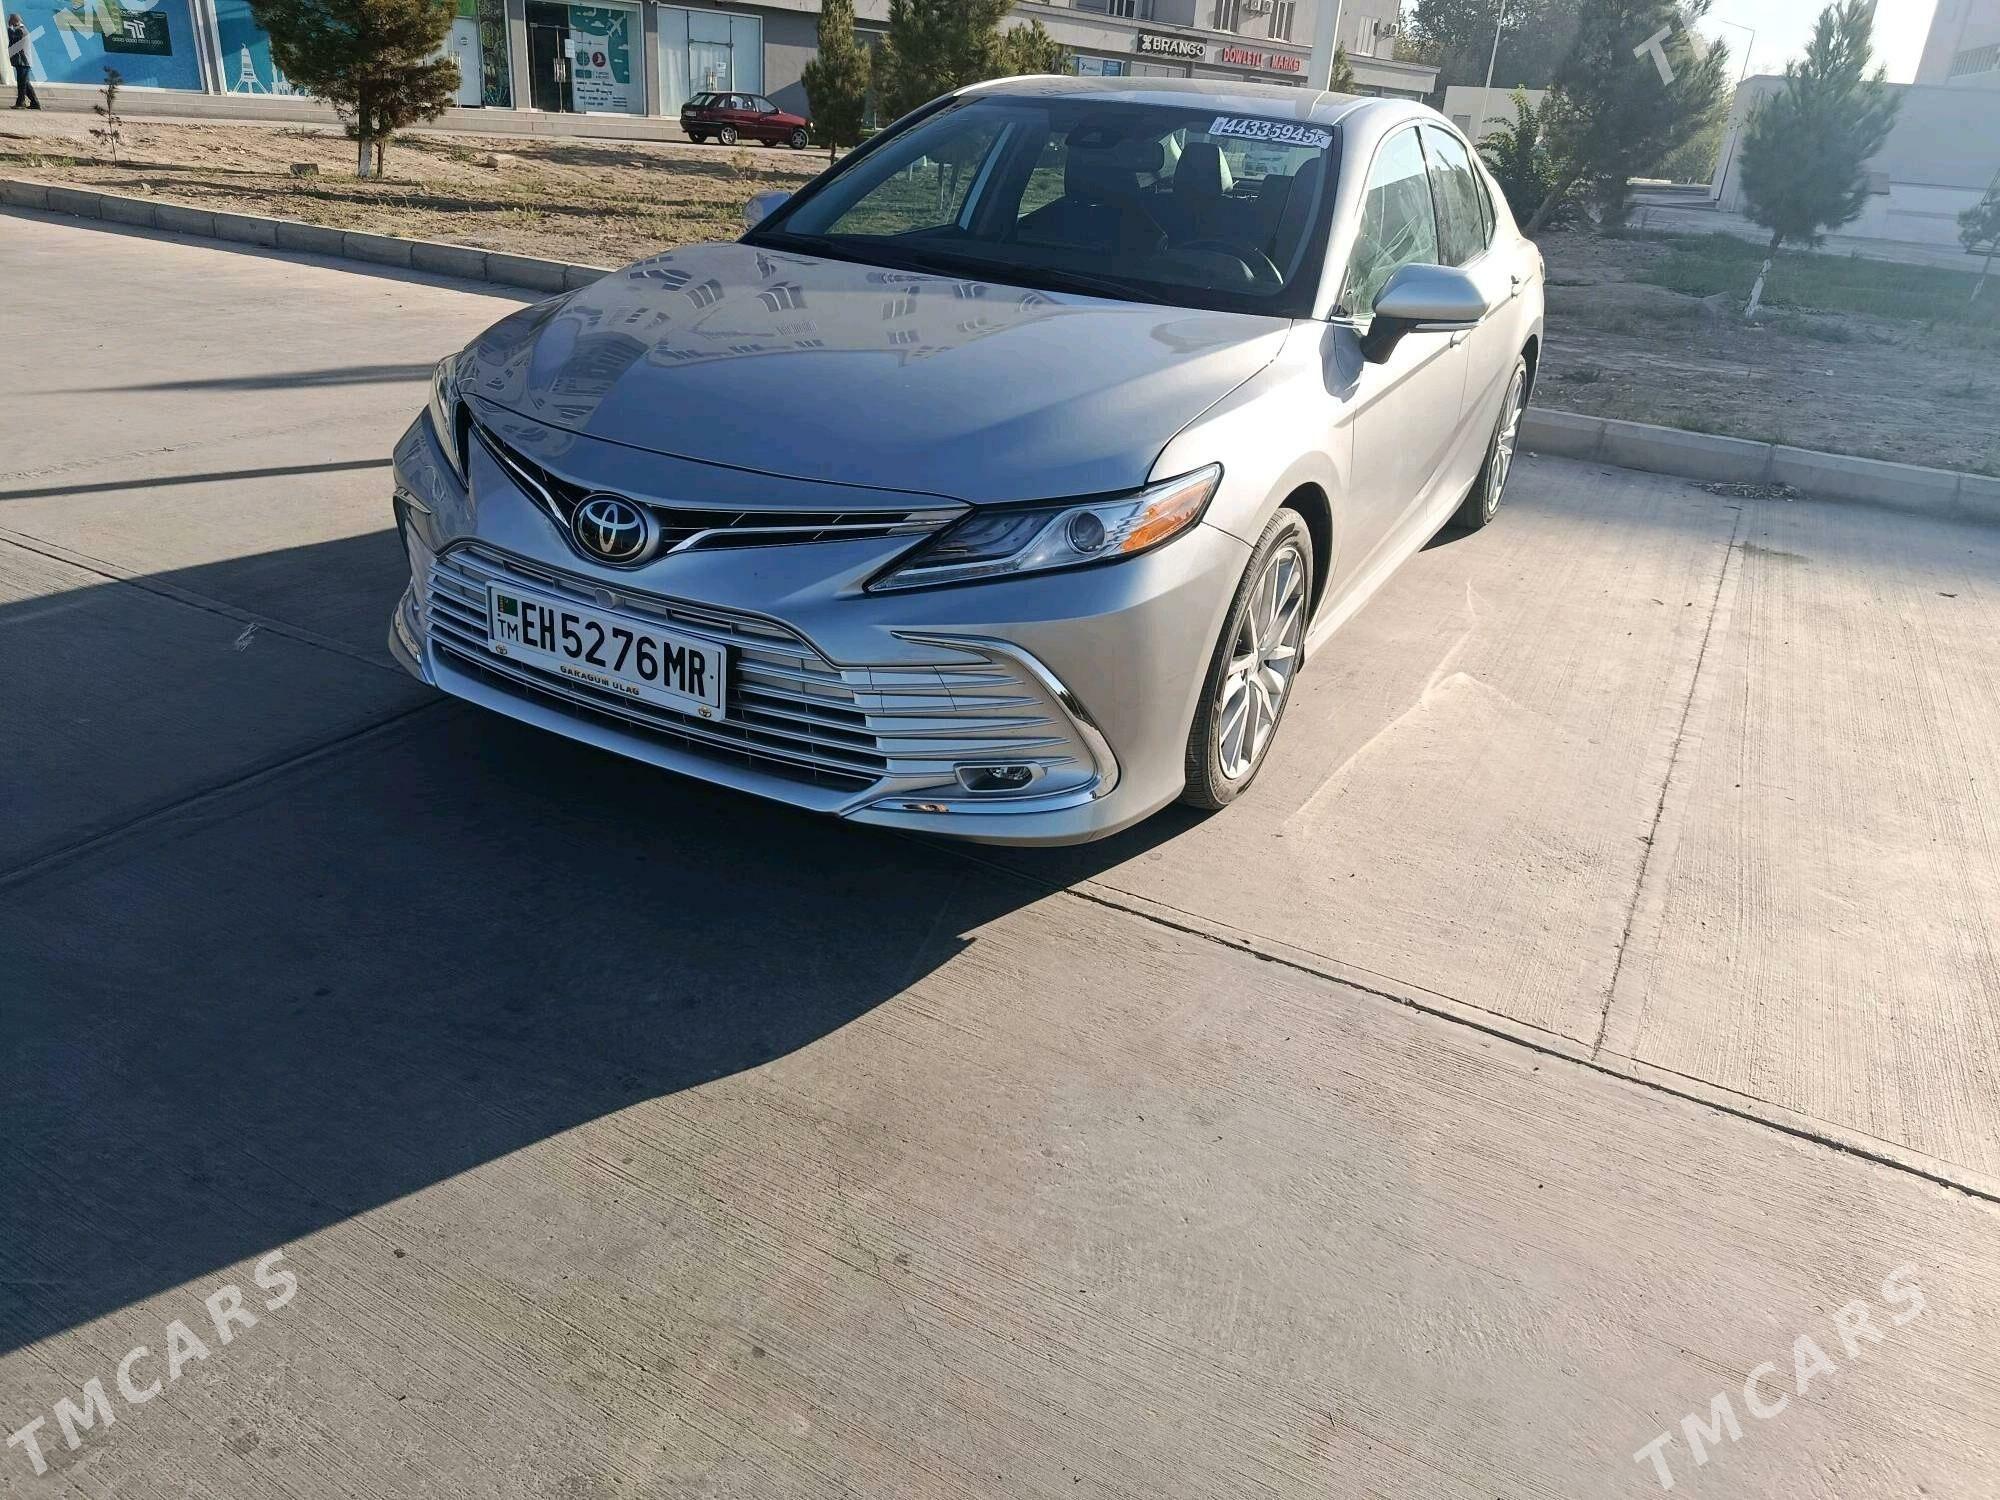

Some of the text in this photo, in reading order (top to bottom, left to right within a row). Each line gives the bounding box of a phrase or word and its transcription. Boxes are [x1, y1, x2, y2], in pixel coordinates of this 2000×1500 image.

[497, 618, 519, 642] TM
[521, 601, 706, 697] EH5276MR
[560, 665, 640, 695] GARAGUM ULAG
